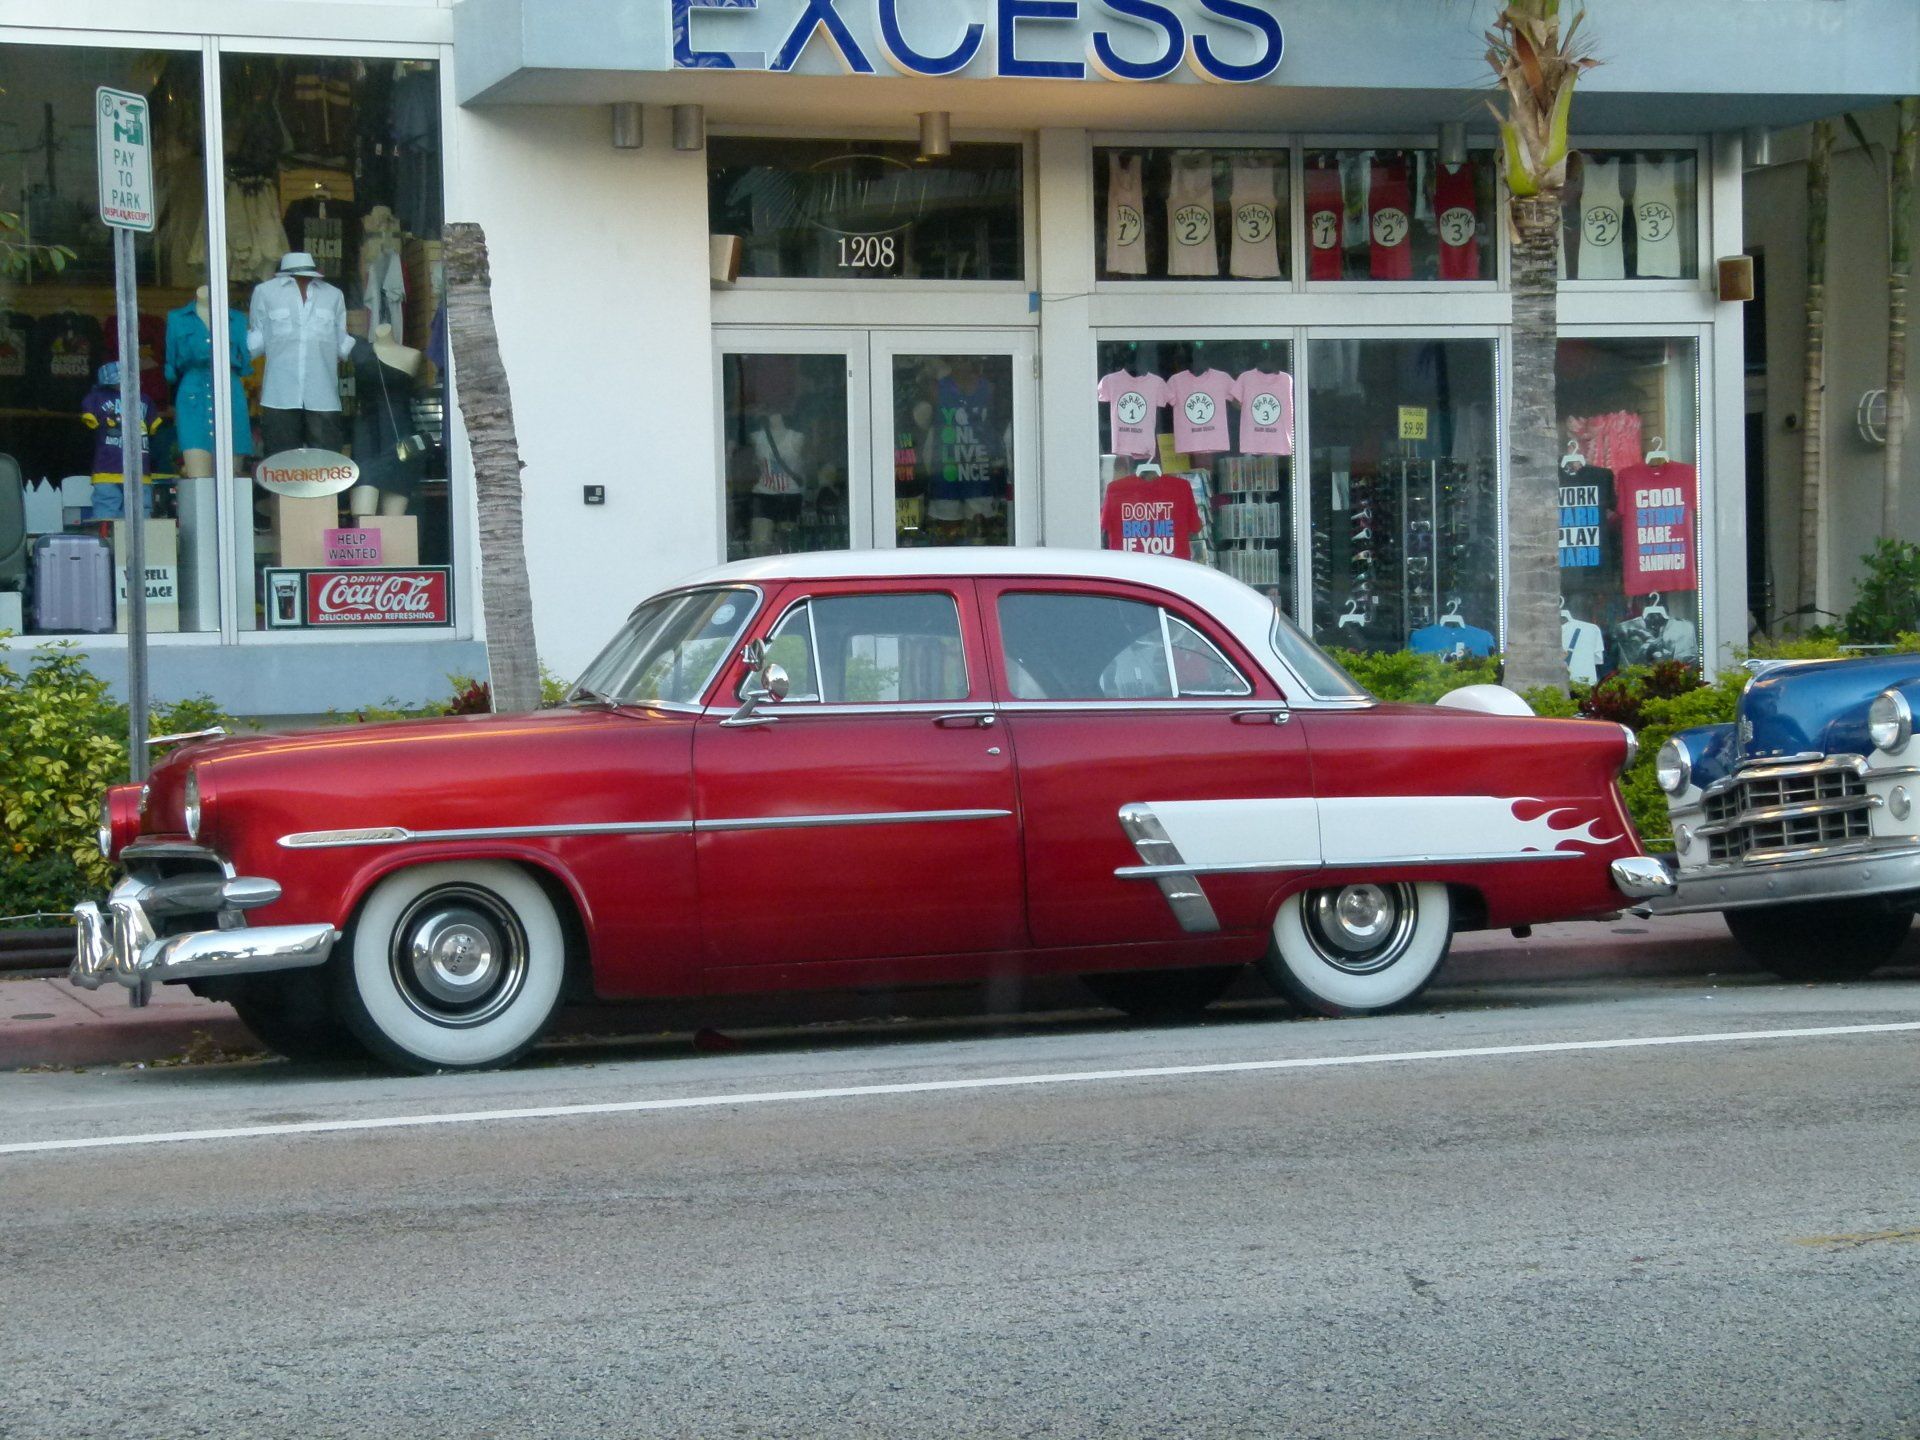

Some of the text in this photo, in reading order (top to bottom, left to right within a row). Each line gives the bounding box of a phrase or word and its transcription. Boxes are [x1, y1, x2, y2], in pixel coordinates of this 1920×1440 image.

[113, 149, 135, 167] PAY
[118, 170, 133, 188] TO
[112, 189, 141, 209] PARK
[1176, 207, 1209, 226] Bitch
[1239, 206, 1270, 224] Bitch
[1587, 210, 1616, 226] SEXY
[1639, 206, 1671, 221] SEXY
[1117, 223, 1127, 241] 1
[1185, 222, 1198, 240] 2
[1248, 220, 1260, 239] 3
[1321, 226, 1329, 245] 1
[1383, 224, 1395, 242] 2
[1451, 223, 1463, 241] 3
[1595, 224, 1607, 242] 2
[1648, 220, 1660, 238] 3
[838, 236, 895, 267] 1208
[1119, 395, 1145, 409] BARBIE
[1187, 395, 1213, 410] BARBIE
[1254, 397, 1279, 411] BARBIE
[1130, 409, 1135, 420] 1
[1196, 410, 1205, 420] 2
[1262, 411, 1270, 421] 3
[941, 426, 979, 444] ONL
[262, 465, 353, 483] havaianas
[1635, 487, 1685, 508] COOL
[1121, 502, 1174, 520] DON'T
[1636, 506, 1685, 527] STORY
[1122, 520, 1174, 538] BRO ME
[337, 533, 367, 545] HELP
[1122, 537, 1175, 554] IF YOU
[329, 548, 377, 559] WANTED
[145, 569, 169, 580] SELL
[349, 575, 385, 583] DRINK
[121, 585, 173, 599] LGAGE
[319, 613, 363, 621] DELICIOUS
[385, 611, 436, 620] REFRESHING
